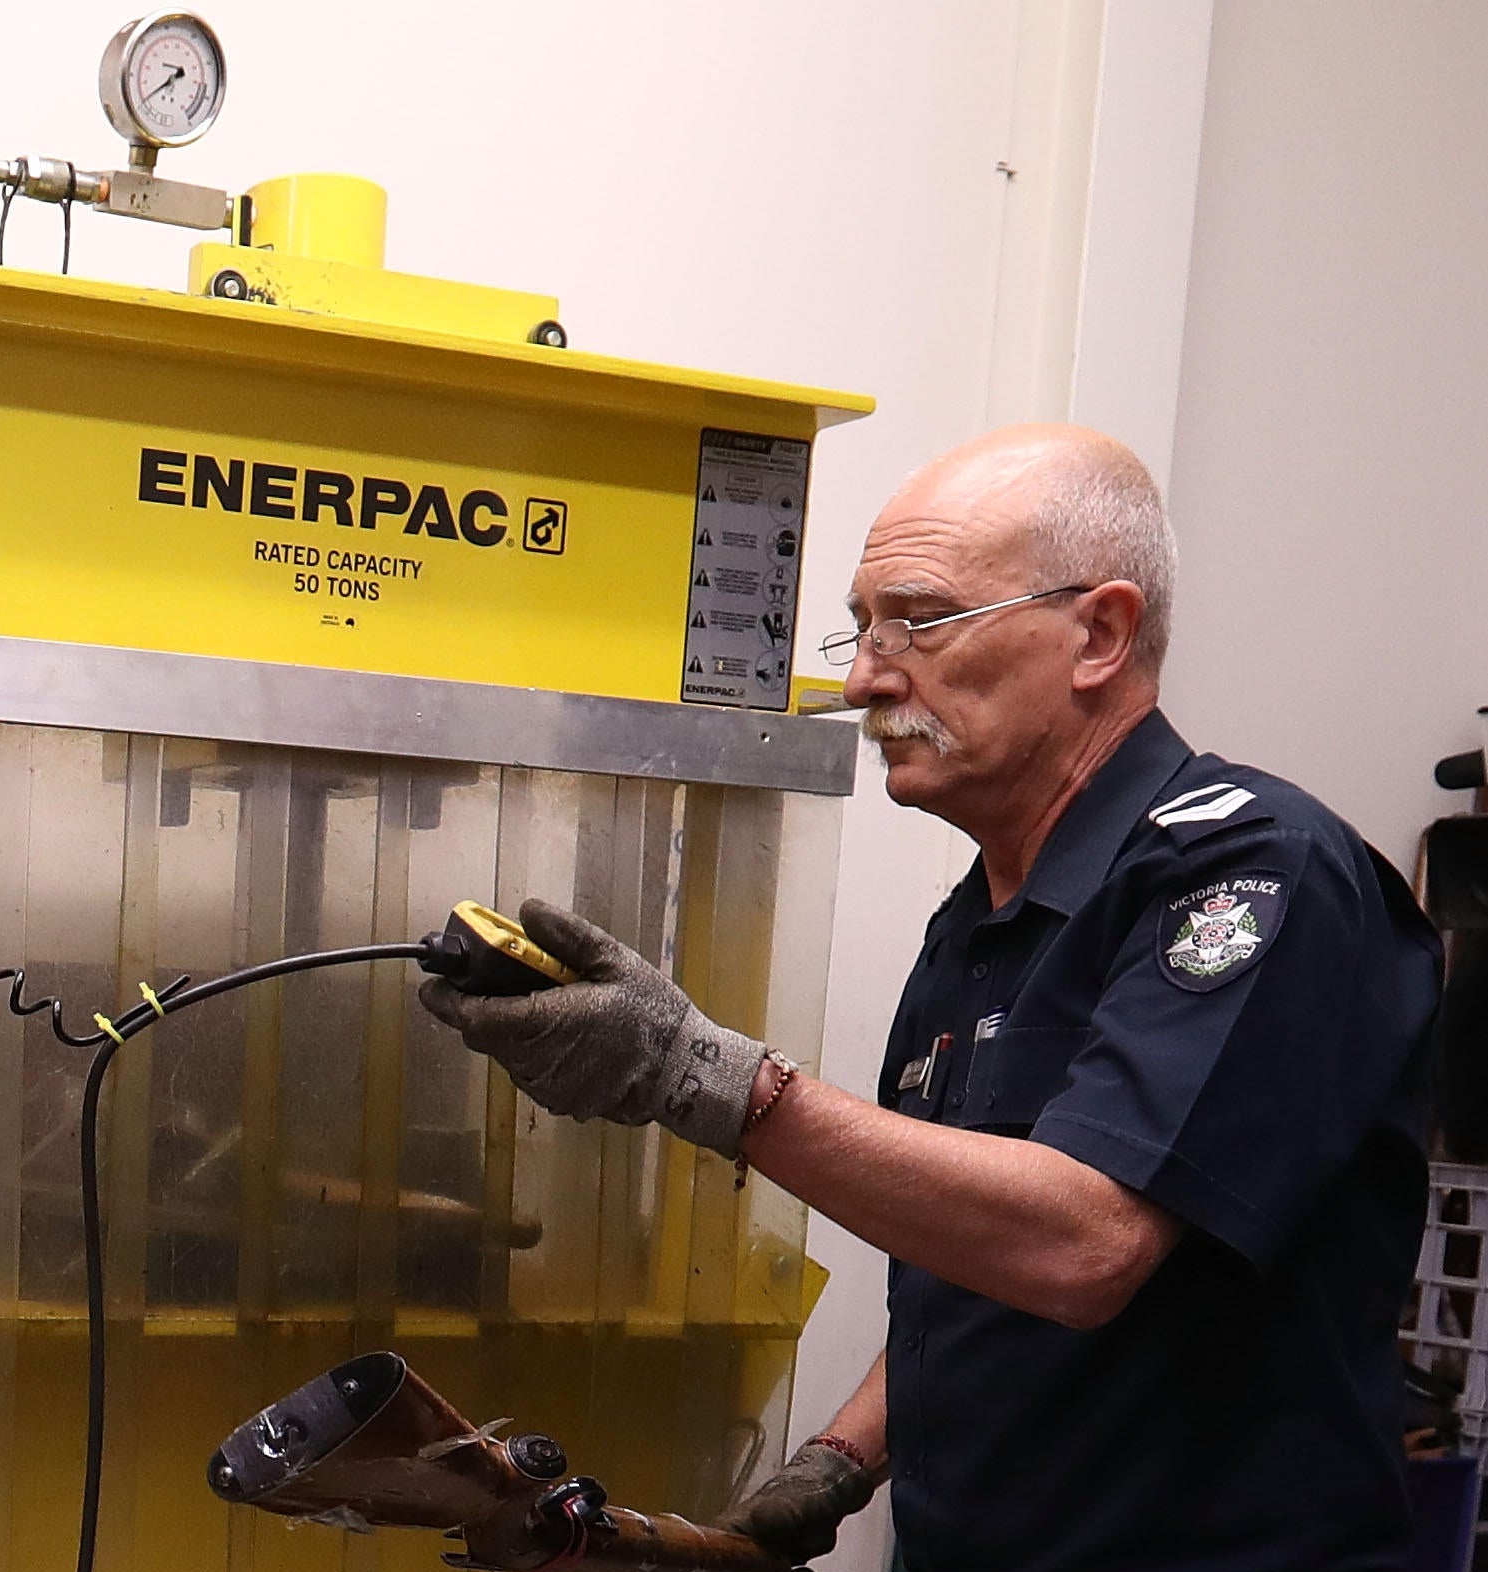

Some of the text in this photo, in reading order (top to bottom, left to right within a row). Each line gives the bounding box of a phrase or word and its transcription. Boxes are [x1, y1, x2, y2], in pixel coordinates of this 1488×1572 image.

[137, 447, 509, 548] ENERPAC
[254, 540, 423, 579] RATED CAPACITY
[293, 573, 381, 602] 50 TONS
[1169, 879, 1281, 912] VICTORIA POLICE
